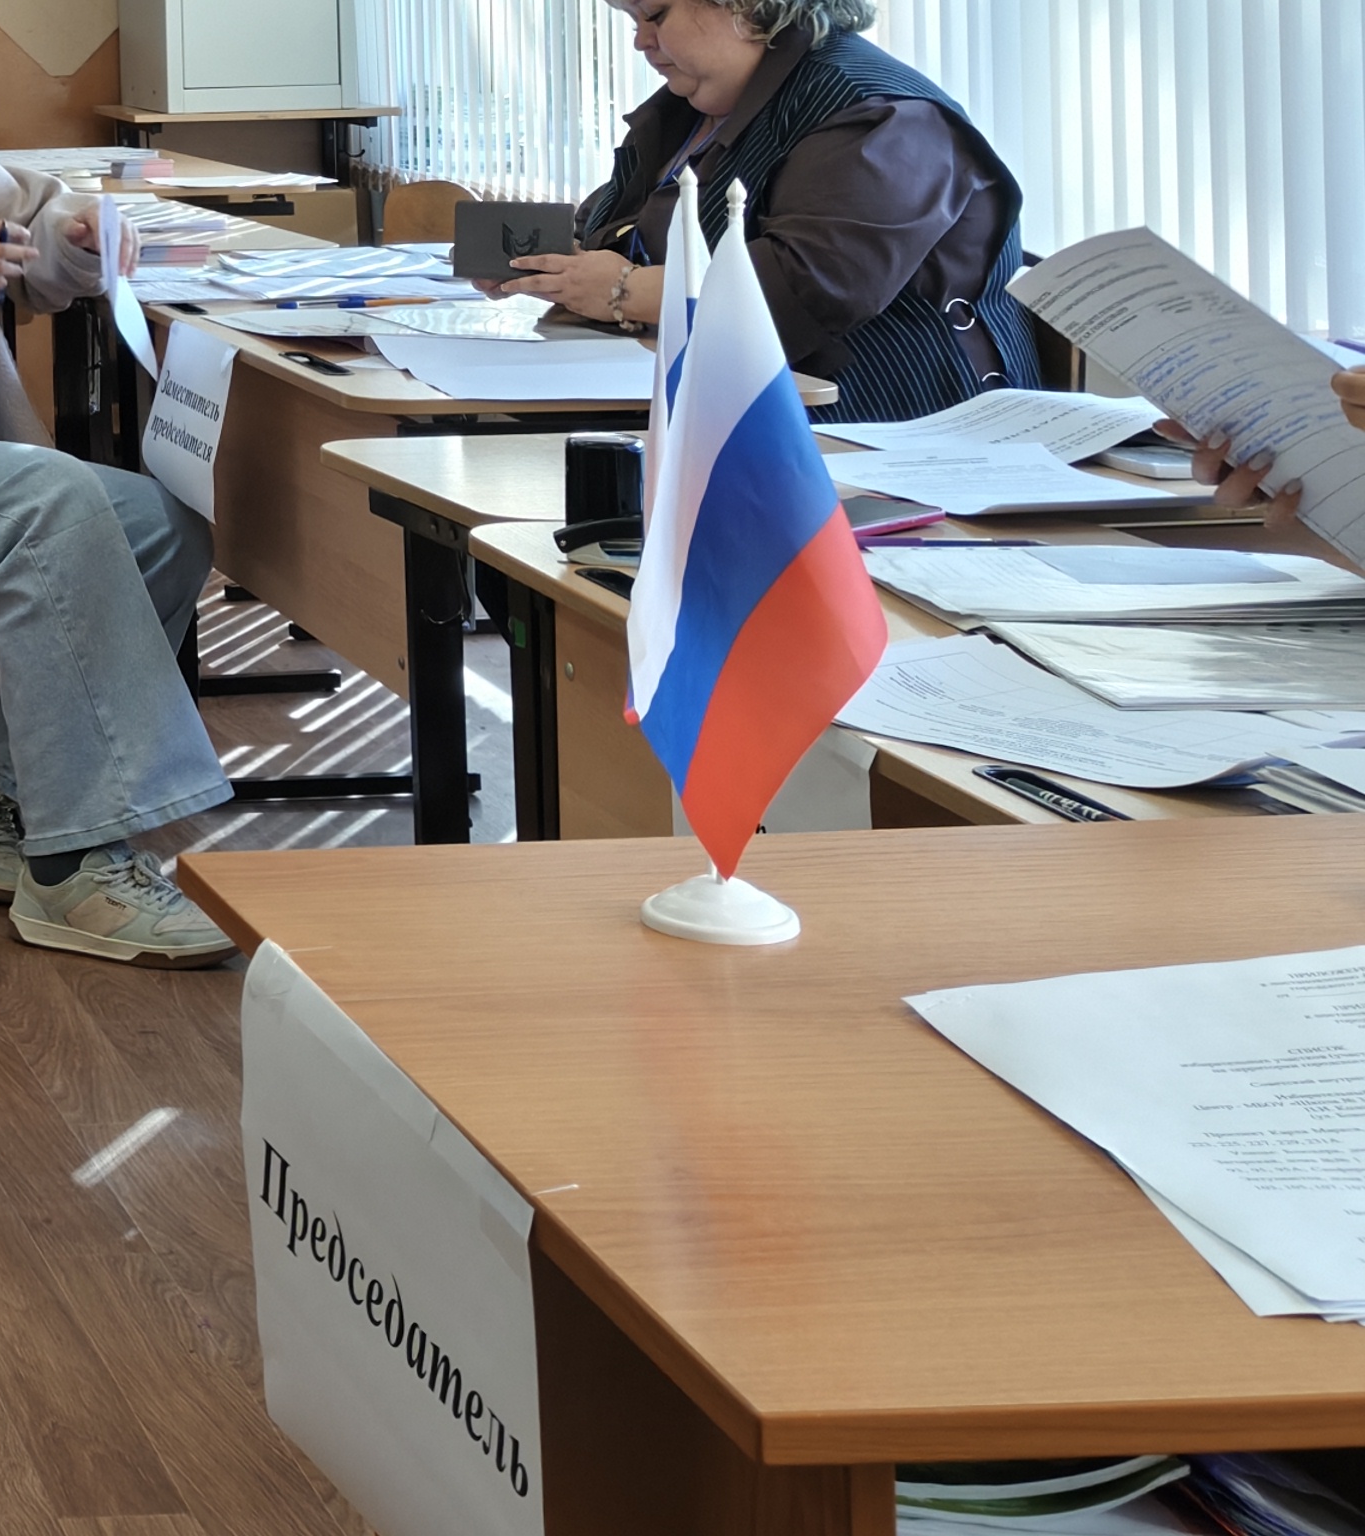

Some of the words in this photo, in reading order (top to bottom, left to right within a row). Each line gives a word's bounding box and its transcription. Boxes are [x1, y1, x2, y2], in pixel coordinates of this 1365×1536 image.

[160, 369, 220, 423] Заместитель
[150, 414, 214, 464] председателя
[260, 1137, 529, 1498] Председатель
